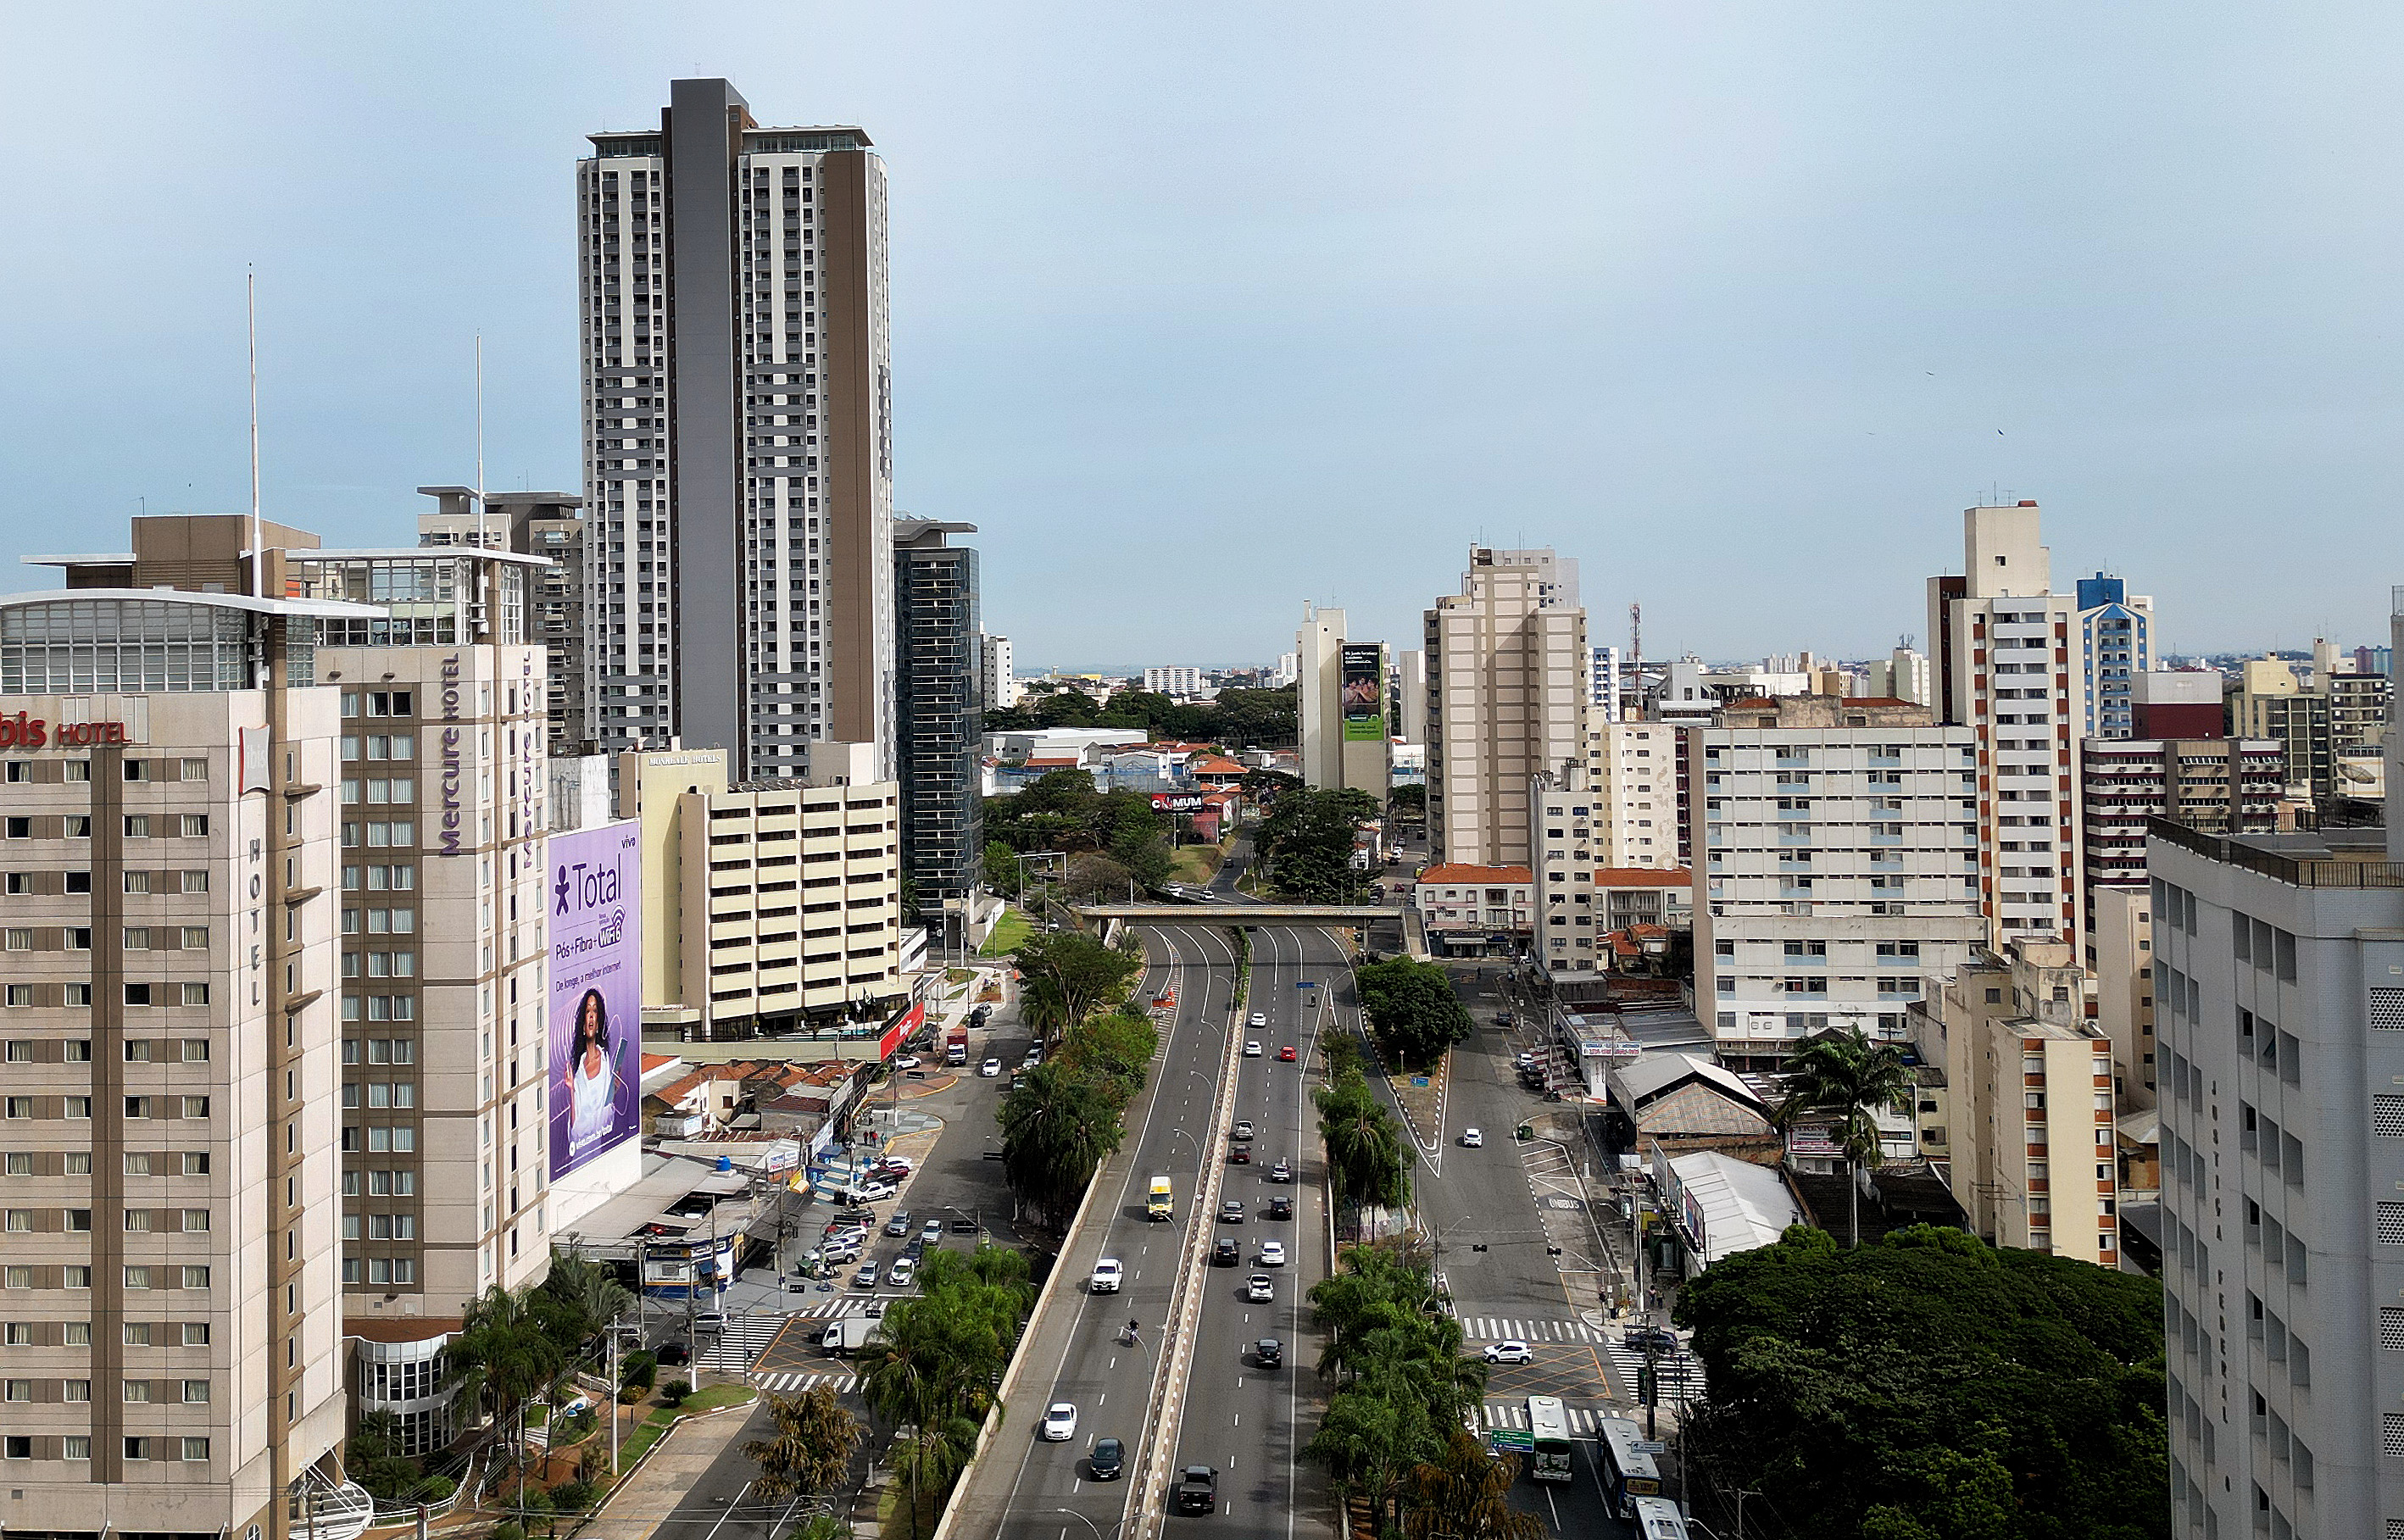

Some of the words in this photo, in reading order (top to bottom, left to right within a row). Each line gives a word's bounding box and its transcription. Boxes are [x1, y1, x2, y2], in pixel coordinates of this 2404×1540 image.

[442, 651, 459, 720] HOTEL
[523, 650, 531, 721] HOTEL
[58, 722, 132, 744] HOTEL
[247, 744, 266, 770] ibis
[692, 753, 721, 764] HOTELS
[441, 726, 460, 855] Mercure
[523, 731, 532, 869] Mercure
[1152, 797, 1201, 809] CMUM
[621, 835, 636, 848] vivo
[572, 853, 621, 911] Total
[249, 837, 260, 1007] HOTEL
[555, 980, 564, 992] De
[2217, 1269, 2229, 1425] FEDERAL
